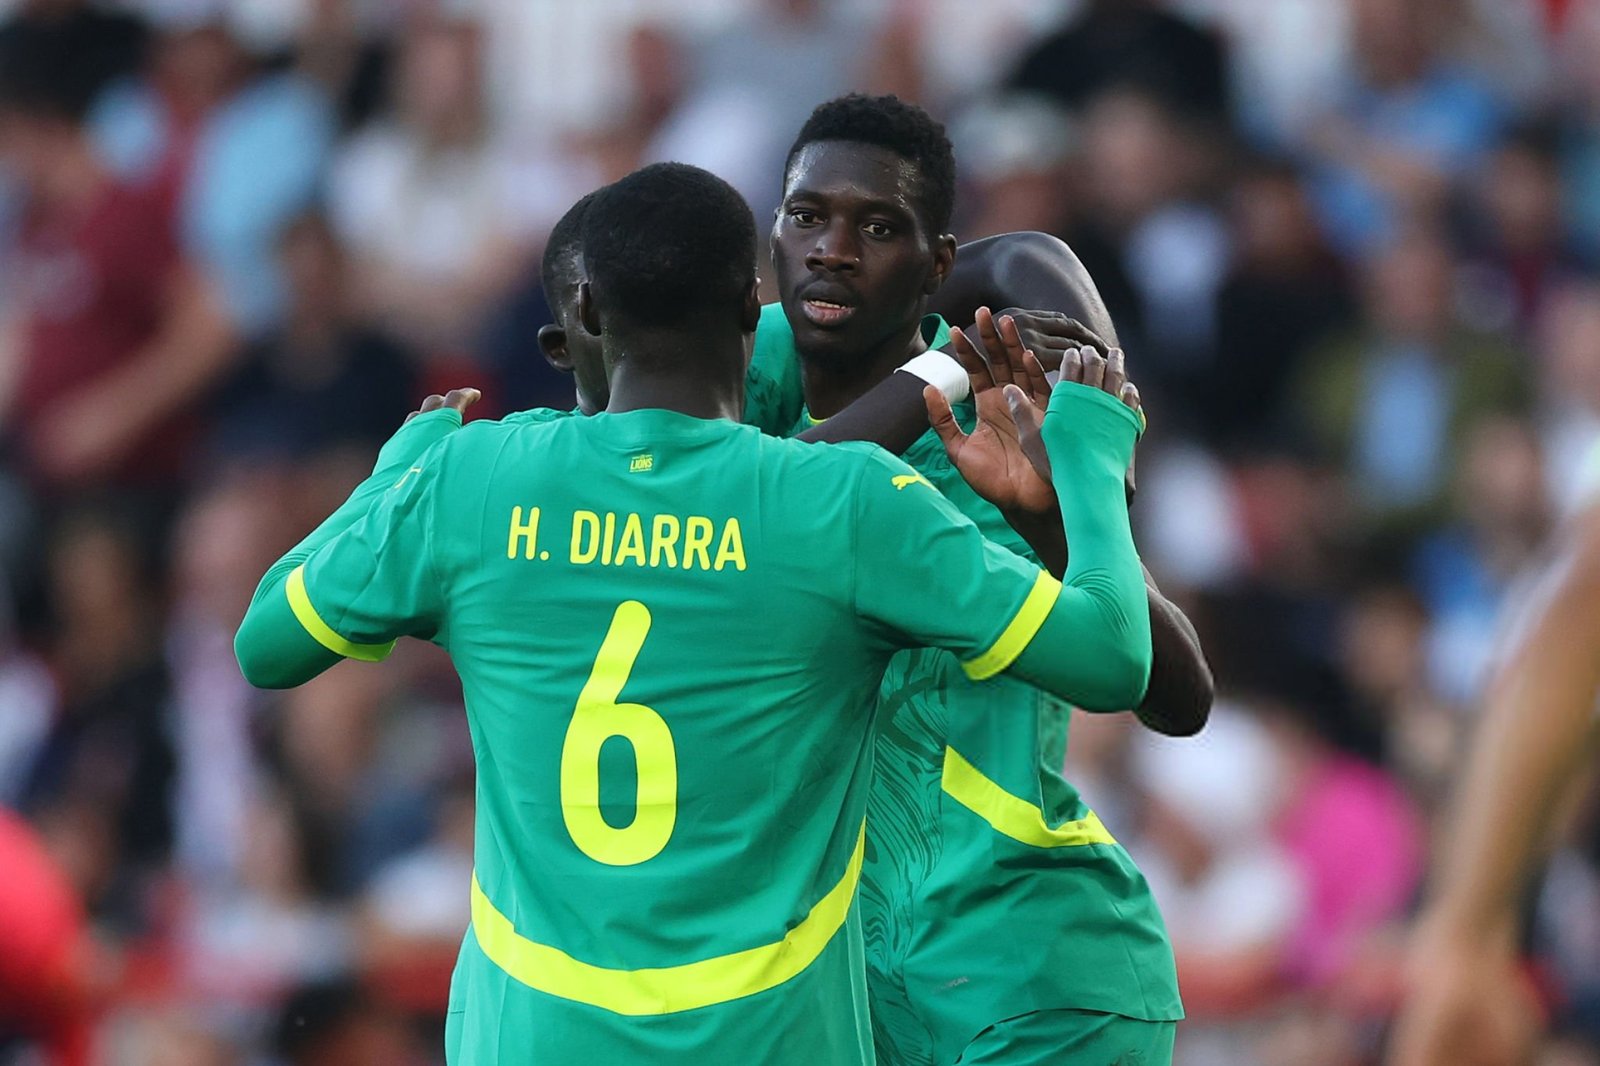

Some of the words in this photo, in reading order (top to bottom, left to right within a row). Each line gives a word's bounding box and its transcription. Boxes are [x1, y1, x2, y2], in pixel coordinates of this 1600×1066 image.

[629, 457, 653, 470] LIONS
[506, 506, 550, 562] H.
[569, 510, 748, 571] DIARRA
[560, 600, 677, 866] 6
